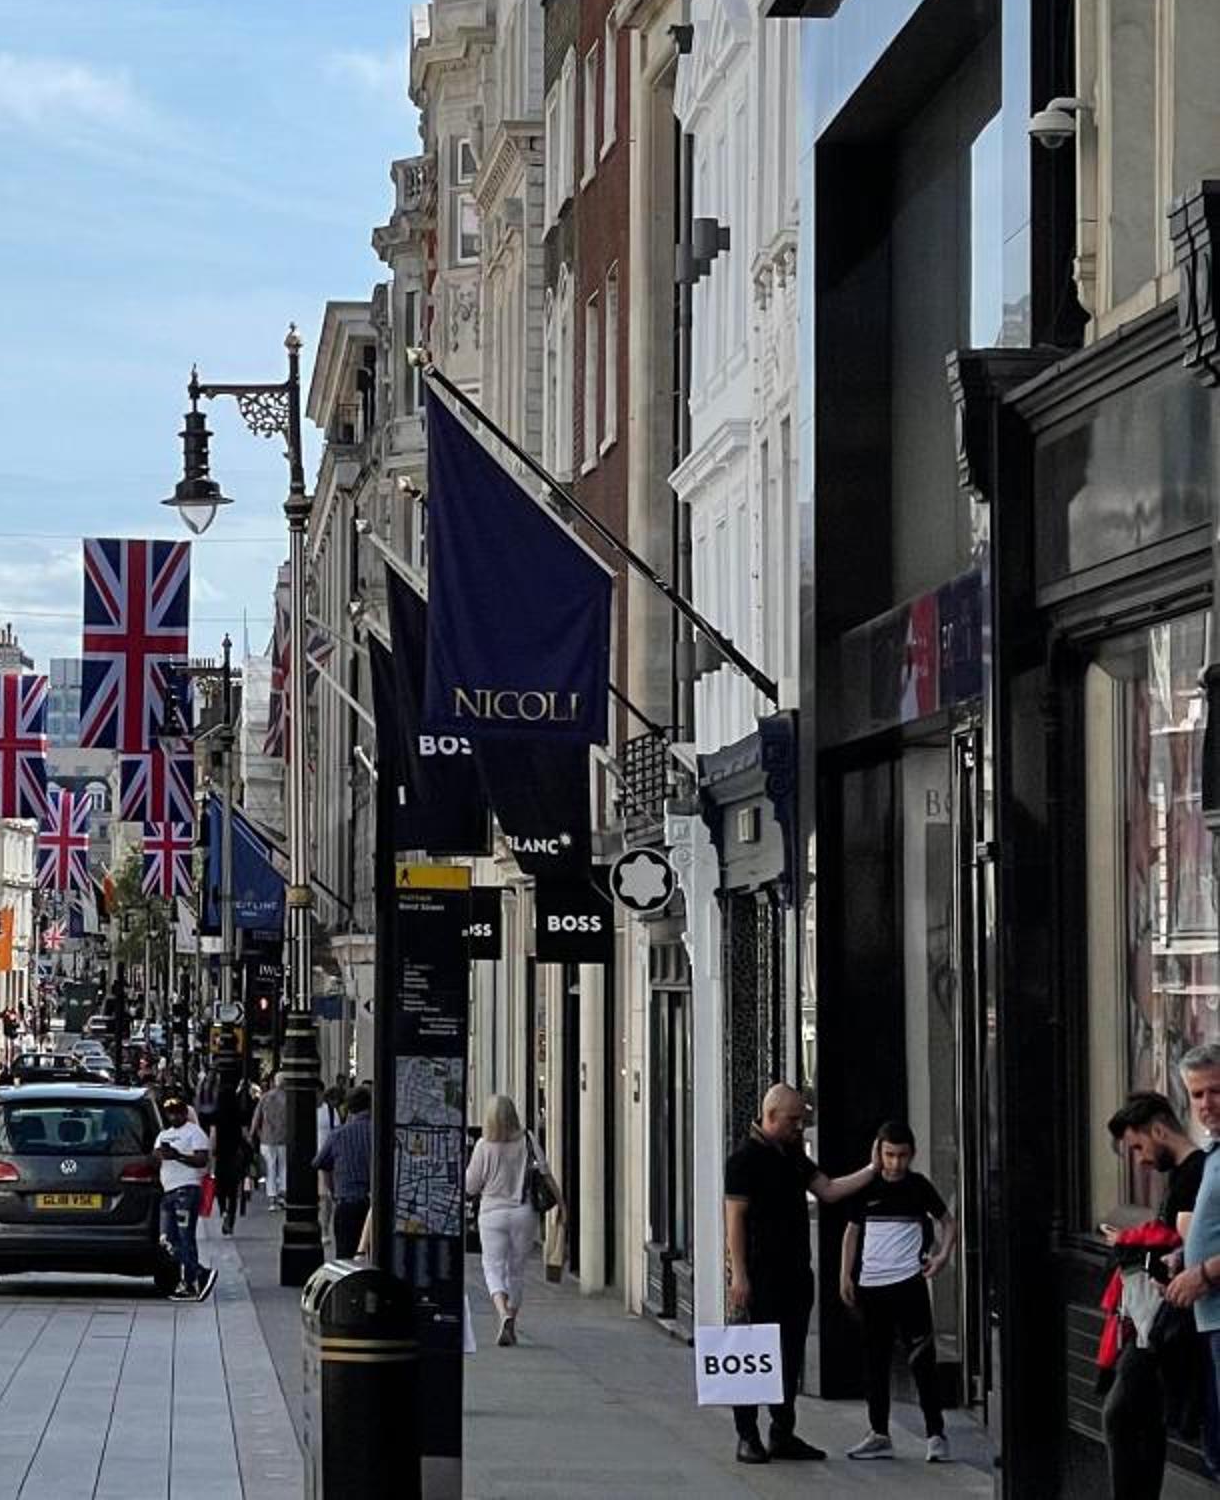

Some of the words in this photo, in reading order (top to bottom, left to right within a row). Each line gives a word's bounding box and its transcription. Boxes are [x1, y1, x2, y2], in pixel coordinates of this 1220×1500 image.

[418, 735, 472, 756] BOS
[547, 915, 602, 932] BOSS
[704, 1353, 773, 1376] BOSS
